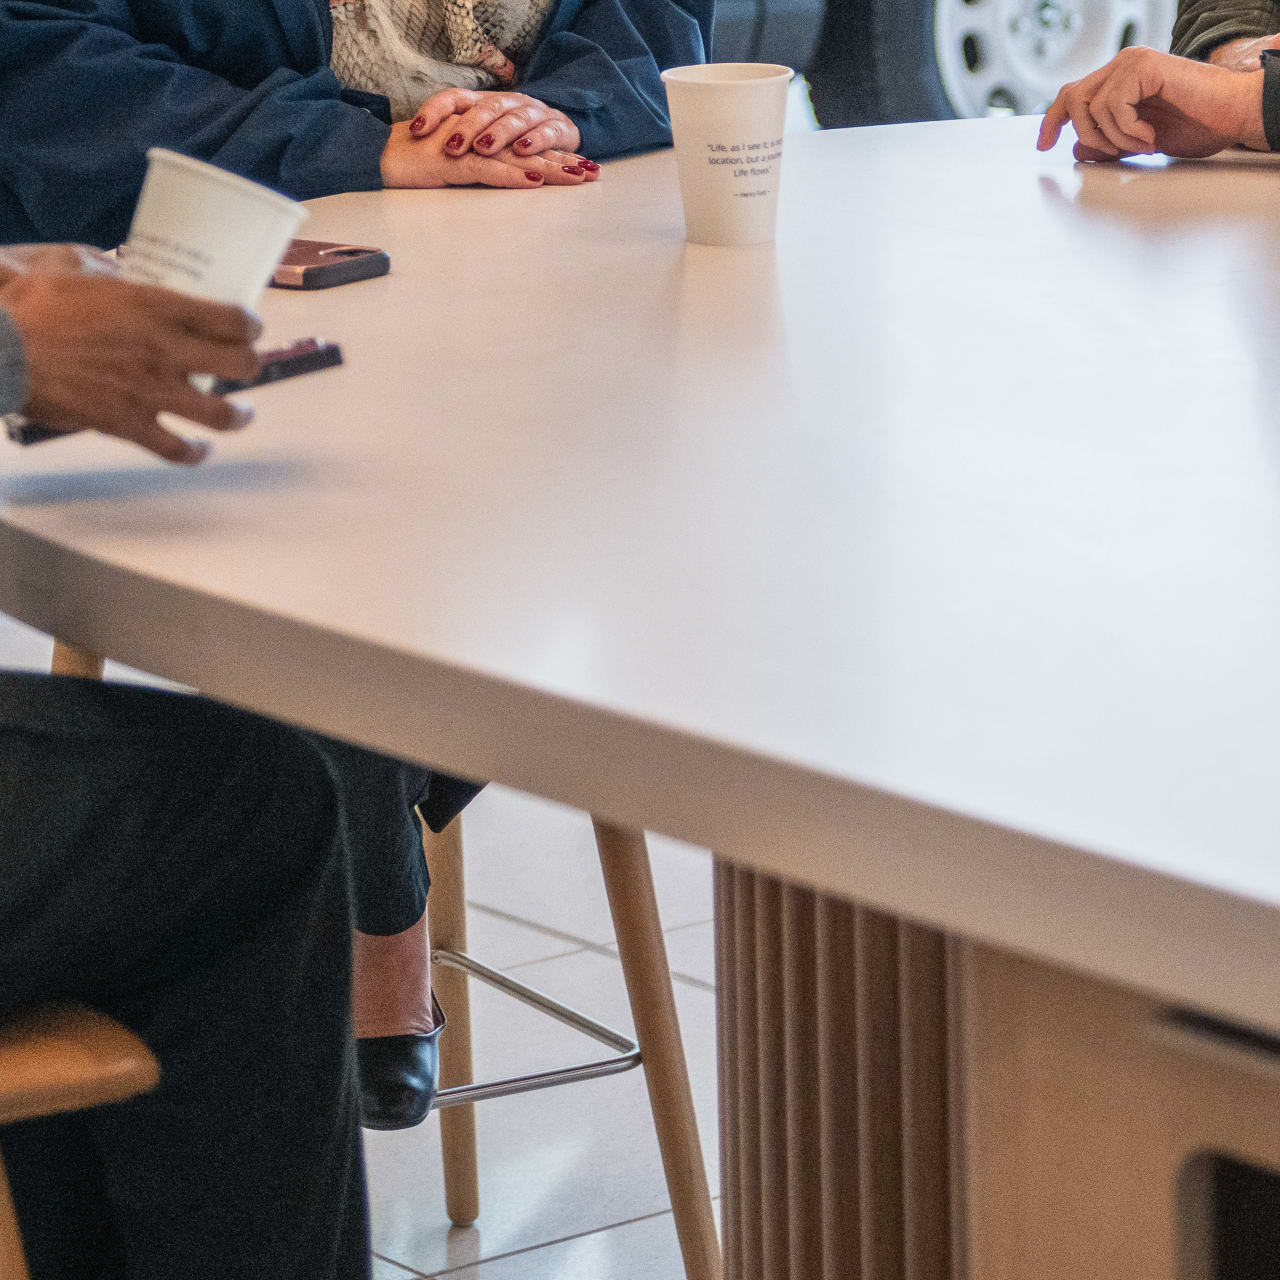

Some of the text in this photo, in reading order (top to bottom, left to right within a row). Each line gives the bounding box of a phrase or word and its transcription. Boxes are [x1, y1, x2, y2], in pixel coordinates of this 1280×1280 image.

[730, 144, 740, 152] as
[747, 143, 761, 151] see
[746, 155, 760, 164] but
[733, 168, 749, 177] Life
